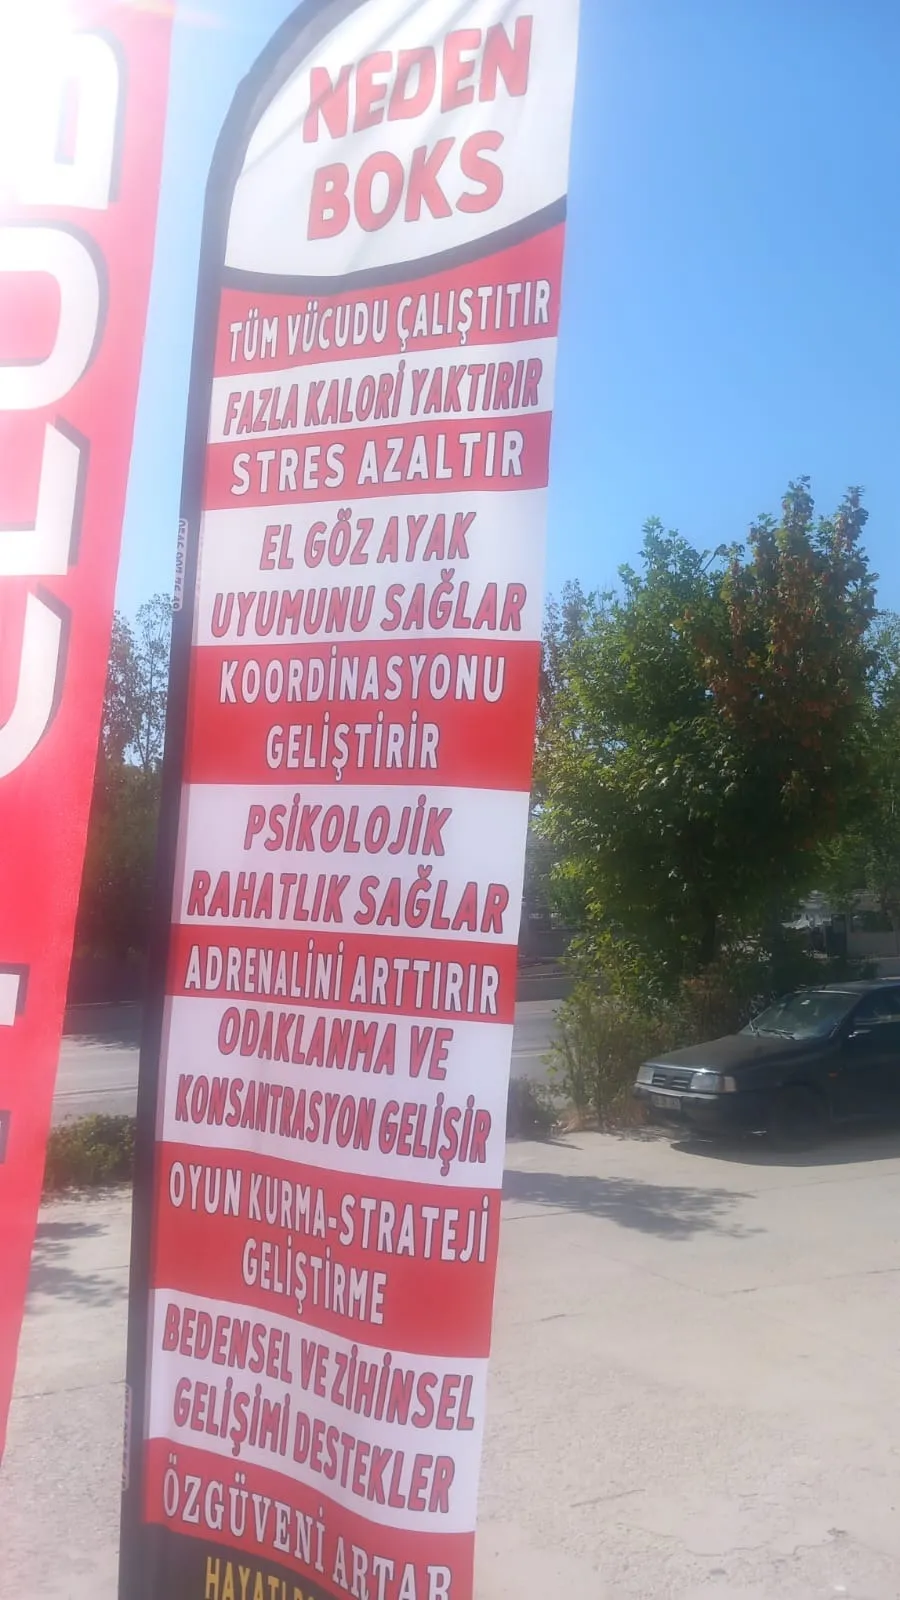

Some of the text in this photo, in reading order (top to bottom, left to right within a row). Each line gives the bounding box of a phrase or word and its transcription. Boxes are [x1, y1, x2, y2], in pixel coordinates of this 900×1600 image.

[303, 14, 534, 143] NEDEN
[307, 129, 505, 241] BOKS
[229, 279, 551, 363] TÜM VÜCUDU ÇALIŞTITIR
[222, 358, 543, 436] FAZLA KALORİ YAKTIRIR
[230, 430, 525, 496] STRES AZALTIR
[258, 508, 477, 571] EL GÖZ AYAK
[211, 568, 527, 638] UYUMUNU SAĞLAR
[219, 645, 507, 704] KOORDİNASYONU
[265, 710, 441, 782] GELİŞTİRİR
[243, 792, 453, 857] PSİKOLOJİK
[186, 864, 510, 934] RAHATLIK SAĞLAR
[184, 938, 500, 1016] ADRENALİNİ ARTTIRIR
[217, 1006, 455, 1081] ODAKLANMA VE
[174, 1073, 492, 1177] KONSANTRASYON GELİŞİR
[168, 1161, 490, 1263] OYUN KURMA-STRATEJİ
[241, 1234, 388, 1327] GELİŞTİRME
[161, 1302, 475, 1432] BEDENSEL VE ZİHİNSEL
[173, 1376, 292, 1457] GELİŞİMİ
[293, 1410, 456, 1515] DESTEKLER
[162, 1453, 453, 1600] ÖZGÜVENİ ARTAR
